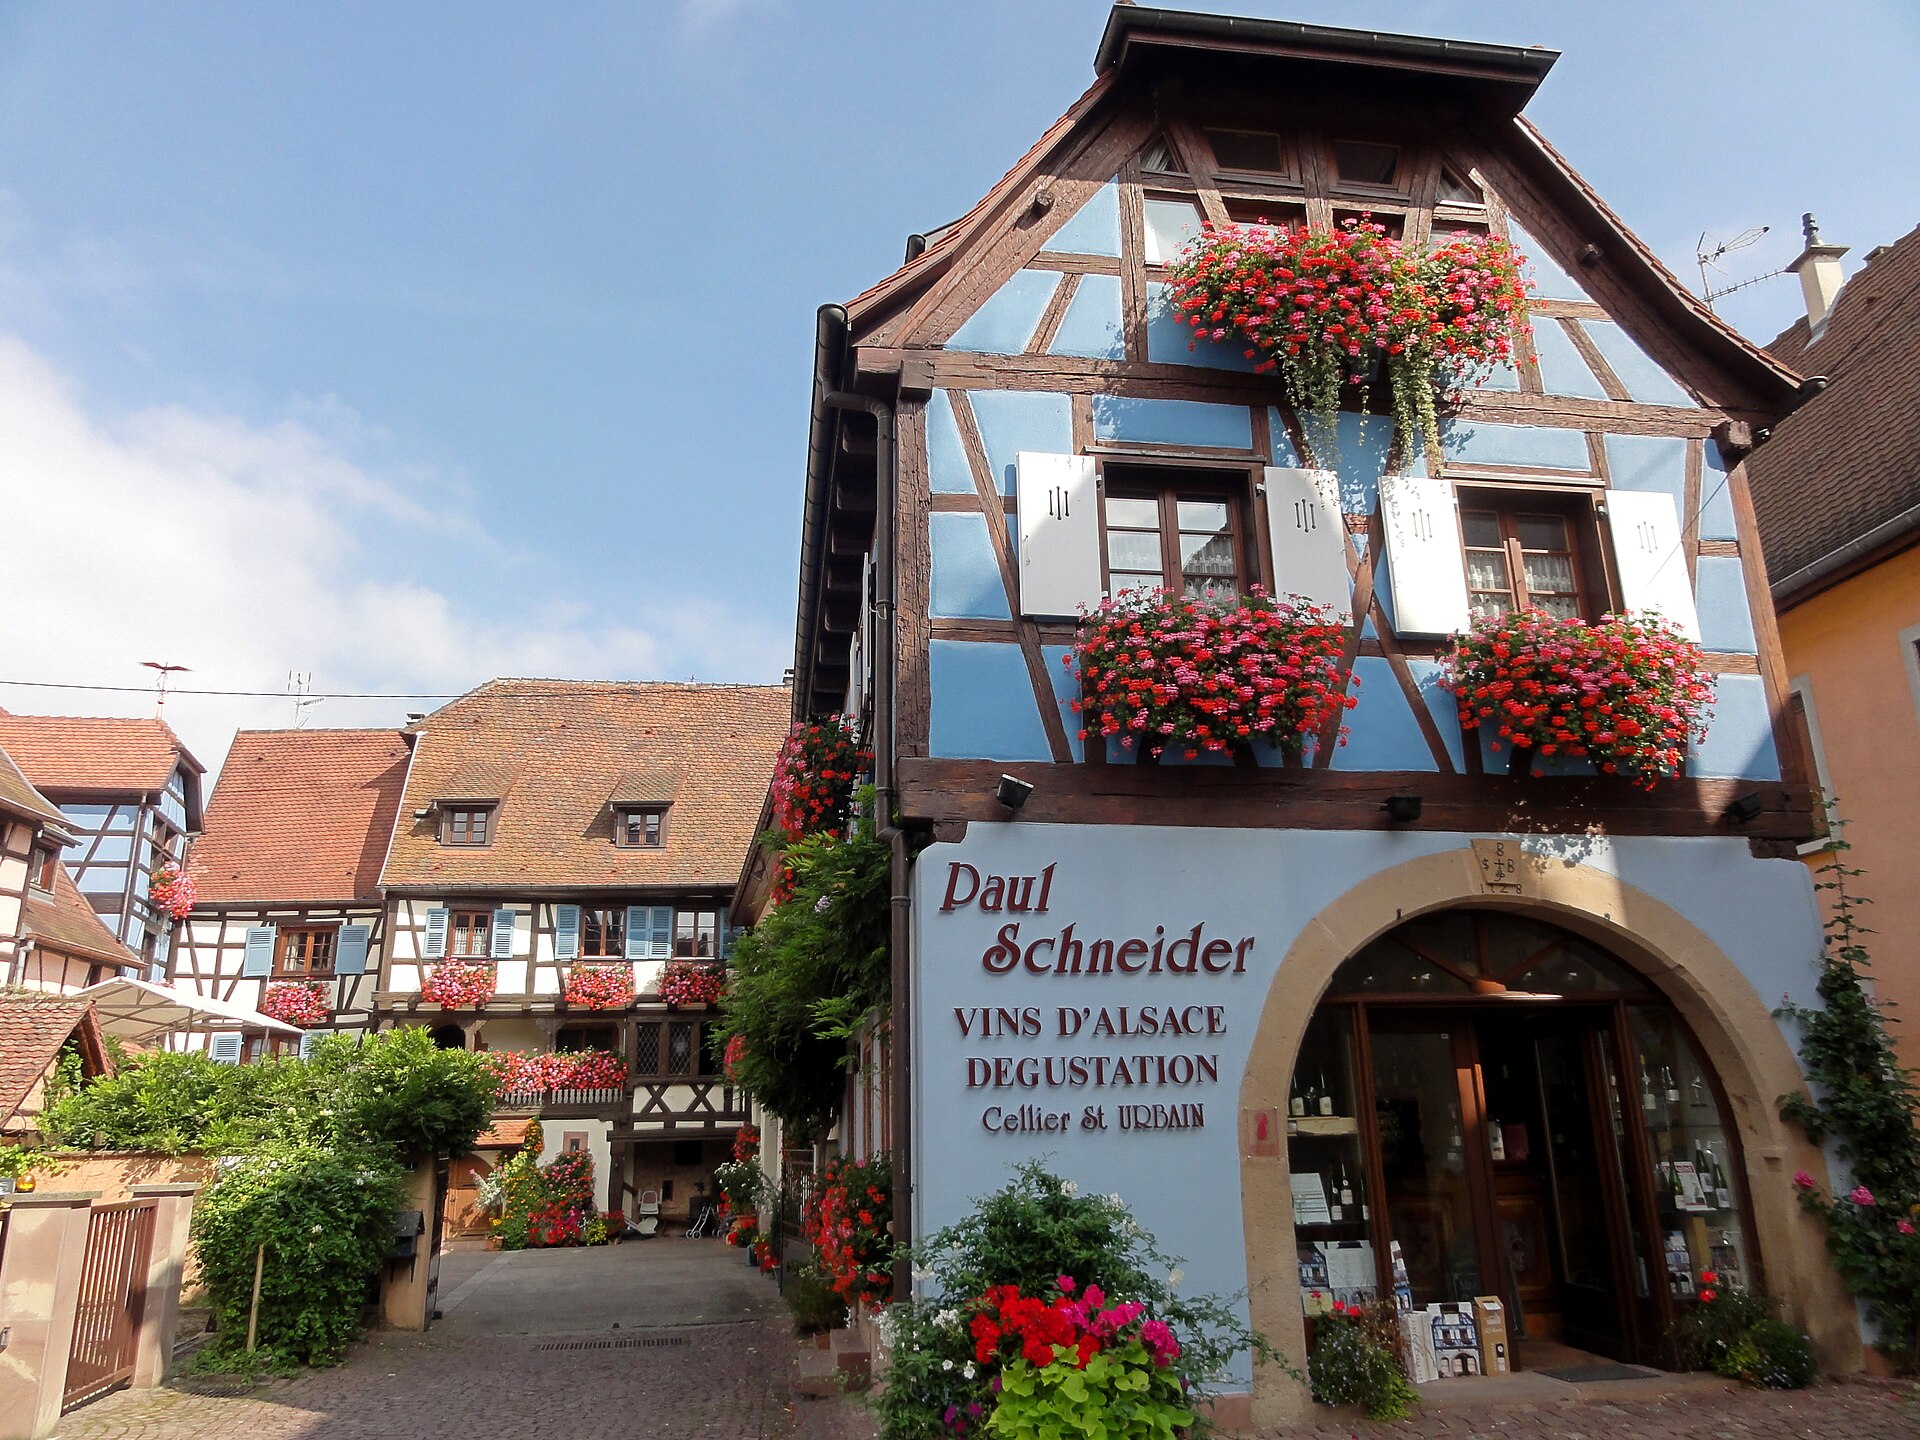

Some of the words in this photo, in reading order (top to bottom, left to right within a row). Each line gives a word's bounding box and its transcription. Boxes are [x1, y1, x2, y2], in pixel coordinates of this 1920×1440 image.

[1496, 842, 1504, 857] B
[1507, 858, 1515, 873] B
[939, 861, 1057, 913] Paul
[982, 921, 1255, 974] Schneider
[953, 1006, 1042, 1037] VINS
[1057, 1005, 1227, 1037] D'ALSACE
[966, 1054, 1219, 1088] DEGUSTATION
[982, 1105, 1070, 1132] Cellier
[1081, 1105, 1107, 1131] St
[1119, 1103, 1205, 1131] URBAIN
